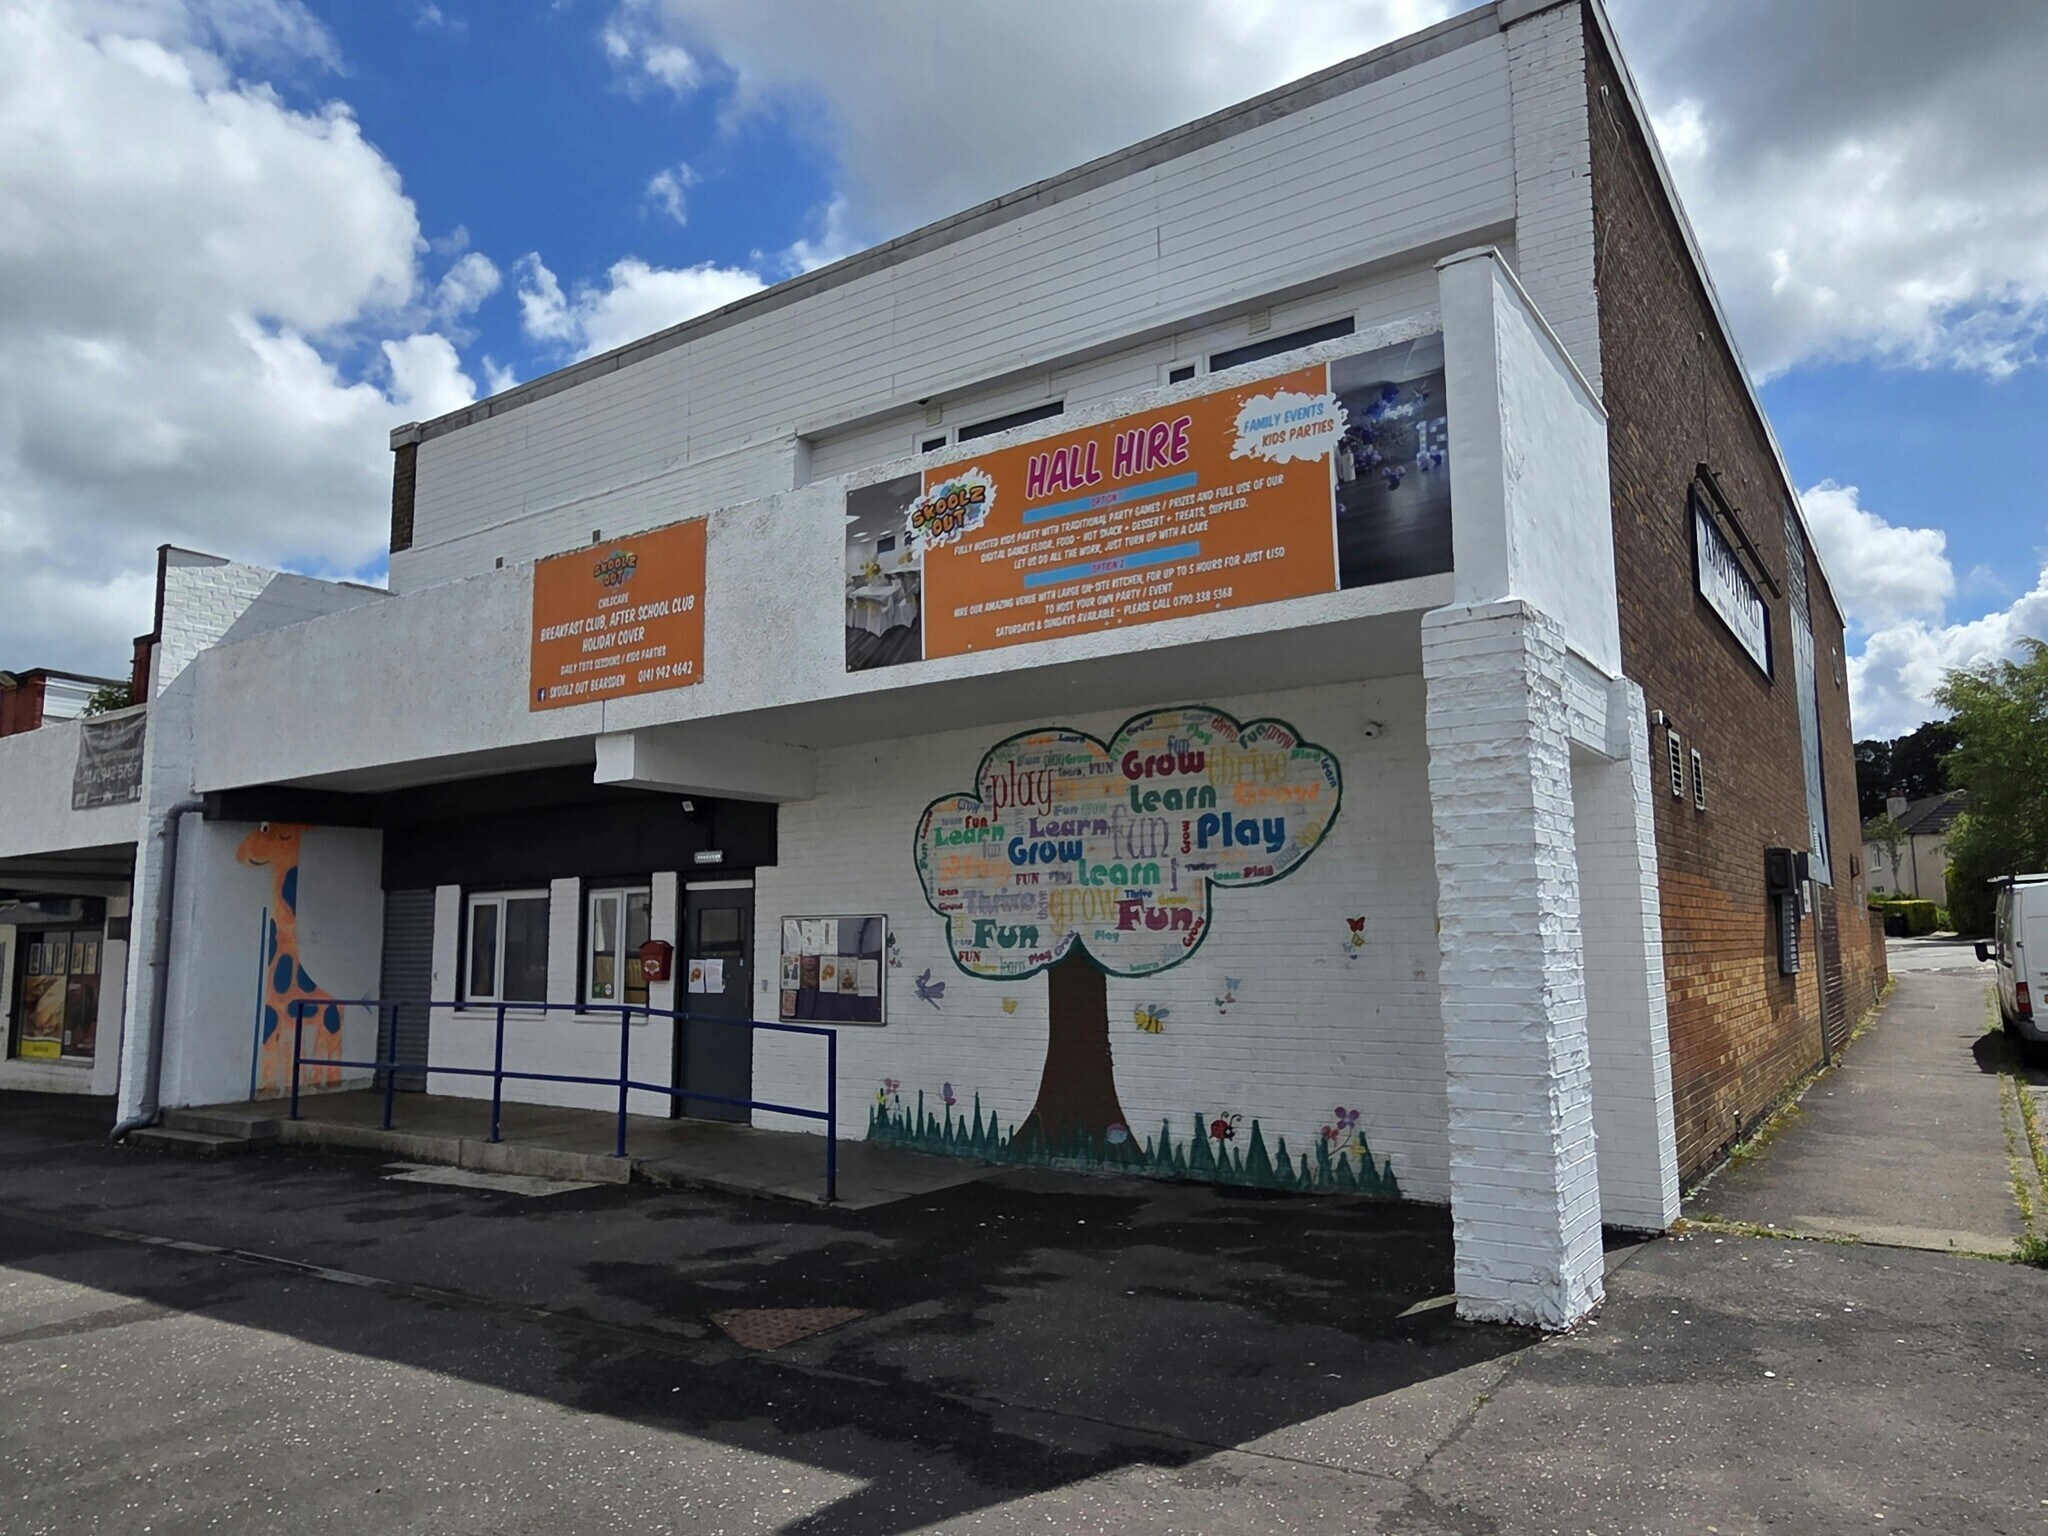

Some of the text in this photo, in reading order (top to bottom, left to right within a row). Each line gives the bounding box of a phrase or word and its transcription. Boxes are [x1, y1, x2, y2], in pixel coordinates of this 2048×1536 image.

[1243, 402, 1324, 434] FAMILY EVENTS
[1261, 418, 1335, 448] KIDS PARTIES
[1026, 415, 1192, 500] HALL HIRE
[912, 485, 986, 528] SKOOLZ
[954, 543, 972, 555] FULLY
[974, 538, 998, 552] HOSTED
[1000, 535, 1015, 547] KIDS
[1017, 529, 1039, 544] PARTY
[1041, 525, 1058, 538] WITH
[1108, 509, 1133, 523] PARTY
[1134, 502, 1160, 517] GAMES
[1169, 497, 1195, 510] PRIZES
[1197, 491, 1213, 504] AND
[1215, 487, 1234, 499] FULL
[1236, 482, 1251, 495] USE
[1253, 478, 1264, 490] OF
[1266, 474, 1284, 487] OUR
[1090, 493, 1118, 507] OPTION
[931, 509, 966, 537] OUT
[980, 549, 1005, 564] DIGITAL
[1007, 545, 1029, 558] DANCE
[1056, 535, 1074, 547] FOOD
[1083, 528, 1098, 542] HOT
[1099, 524, 1123, 539] SNACK
[1131, 515, 1164, 531] DESSERT
[1174, 508, 1206, 523] TREATS,
[1208, 498, 1249, 515] SUPPLIED.
[1014, 556, 1026, 570] LET
[1027, 555, 1038, 567] US
[1038, 553, 1048, 565] DO
[1049, 550, 1063, 562] ALL
[1064, 547, 1078, 559] THE
[1104, 538, 1122, 552] JUST
[1125, 534, 1145, 547] TURN
[1147, 531, 1157, 543] UP
[1158, 527, 1179, 541] WITH
[1180, 524, 1187, 536] A
[1188, 520, 1208, 533] CAKE
[593, 555, 638, 578] SKOOLZ
[1091, 559, 1125, 573] OPTION 2
[954, 605, 969, 618] HIRE
[970, 603, 983, 615] OUR
[985, 597, 1014, 613] AMAZING
[1015, 593, 1037, 606] VENUE
[1038, 590, 1056, 602] WITH
[1057, 586, 1080, 599] LARGE
[1146, 570, 1161, 582] FOR
[1163, 566, 1175, 578] UP
[1177, 563, 1187, 576] TO
[1196, 557, 1223, 573] HOURS
[1224, 553, 1240, 567] FOR
[1242, 550, 1264, 564] JUST
[1045, 602, 1055, 614] TO
[1055, 599, 1075, 612] HOST
[1076, 595, 1096, 609] YOUR
[1096, 591, 1114, 605] OWN
[1115, 587, 1141, 601] PARTY
[1149, 582, 1173, 596] EVENT
[598, 592, 629, 609] CHILDCARE
[995, 621, 1035, 637] SATURDAYS
[1043, 614, 1075, 629] SUNDAYS
[1076, 607, 1115, 623] AVAILABLE
[1123, 600, 1150, 615] PLEASE
[1152, 596, 1171, 609] CALL
[1173, 592, 1193, 606] 0790
[1196, 590, 1210, 603] 338
[540, 594, 695, 642] BREAKFAST CLUB, AFTER SCHOOL CLUB
[582, 626, 645, 652] HOLIDAY COVER
[560, 664, 577, 676] DAILY
[578, 661, 593, 672] TOTS
[626, 651, 640, 663] KIDS
[641, 645, 667, 660] PARTIES
[549, 684, 574, 698] SKOOLZ
[575, 681, 589, 694] OUT
[590, 674, 626, 692] BEARSDEN
[638, 668, 653, 683] 0141
[655, 665, 670, 679] 942
[672, 661, 693, 676] 4642
[1122, 750, 1205, 780] Grow
[989, 761, 1055, 822] play
[934, 823, 1005, 848] Learn
[1028, 817, 1109, 838] Learn
[1111, 804, 1170, 861] fun
[1197, 811, 1286, 854] Play
[1007, 836, 1083, 866] Grow
[1015, 872, 1039, 885] FUN
[1115, 898, 1194, 931] Fun
[971, 919, 1039, 949] Fun
[959, 951, 981, 962] FUN
